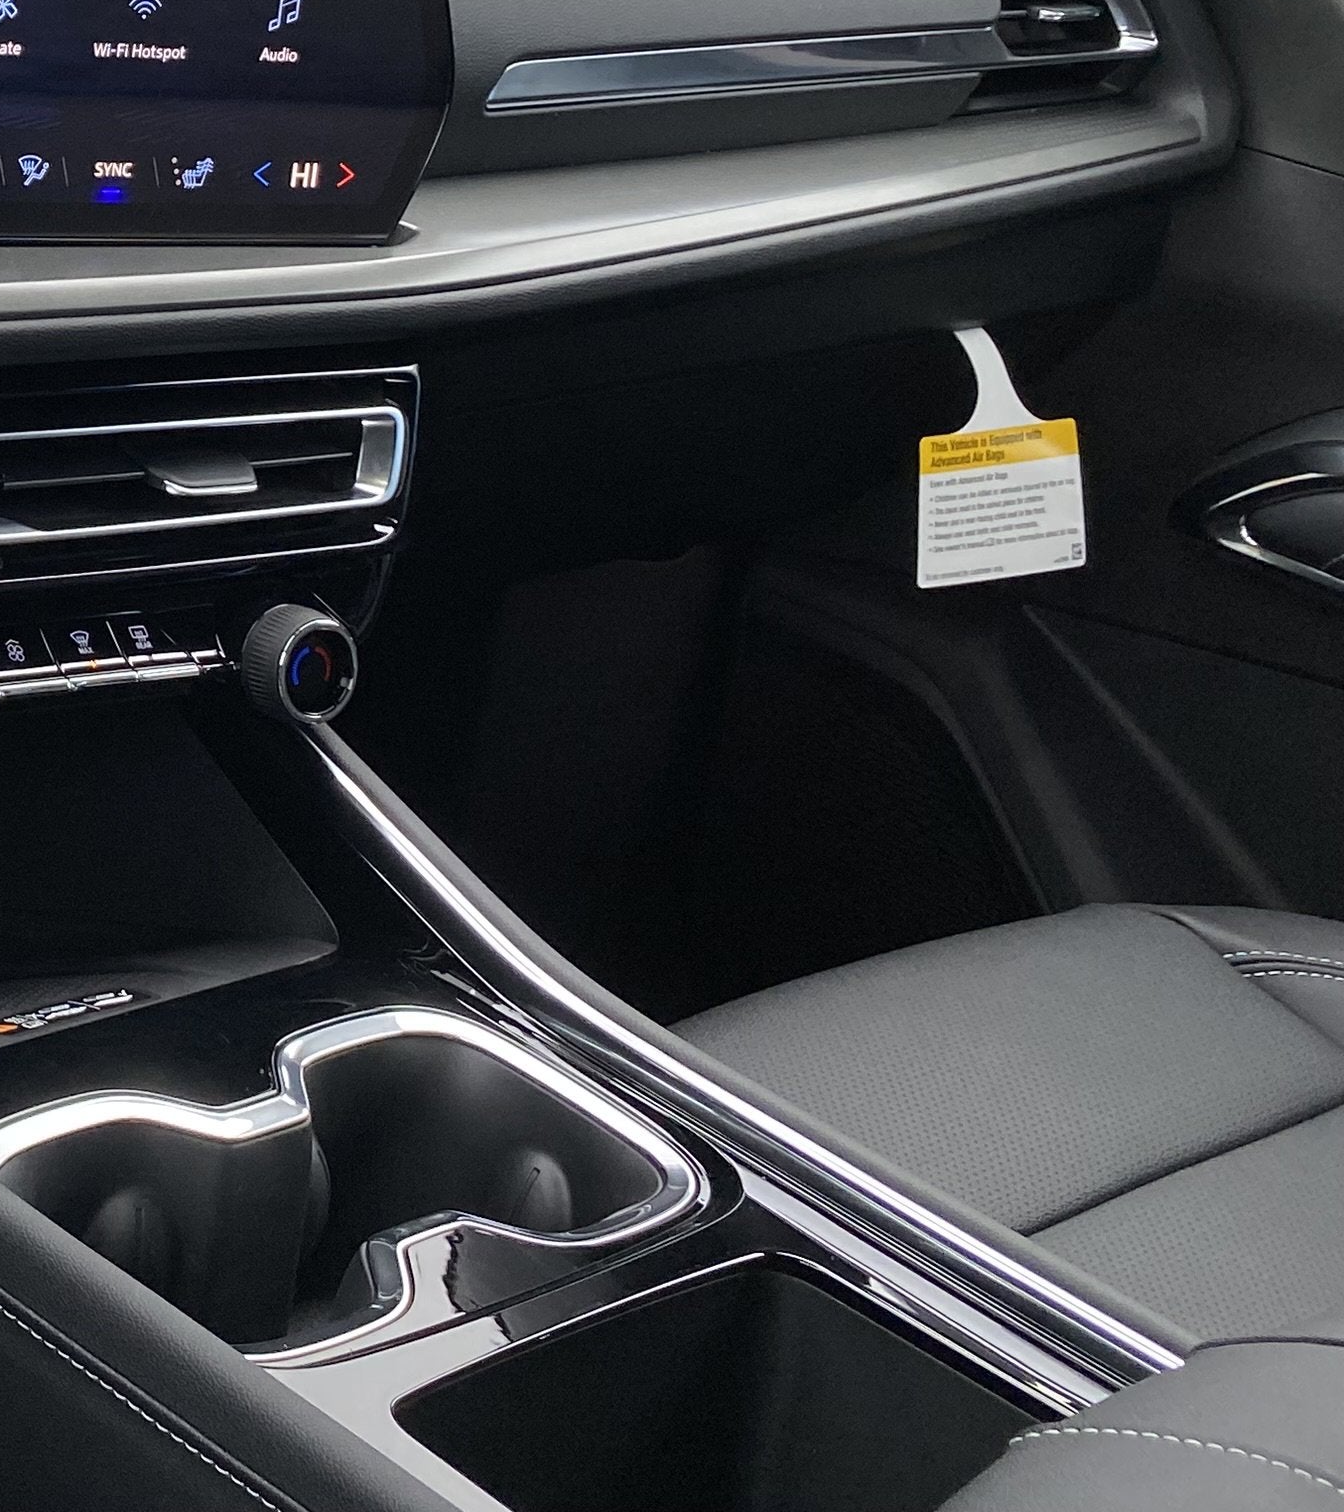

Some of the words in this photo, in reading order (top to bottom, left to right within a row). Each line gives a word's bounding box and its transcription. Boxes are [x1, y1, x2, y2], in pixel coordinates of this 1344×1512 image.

[93, 42, 129, 59] Wi-Fi
[131, 43, 186, 62] Hotspot
[259, 46, 298, 63] Audio
[93, 161, 133, 178] SYNC
[289, 161, 320, 189] HI
